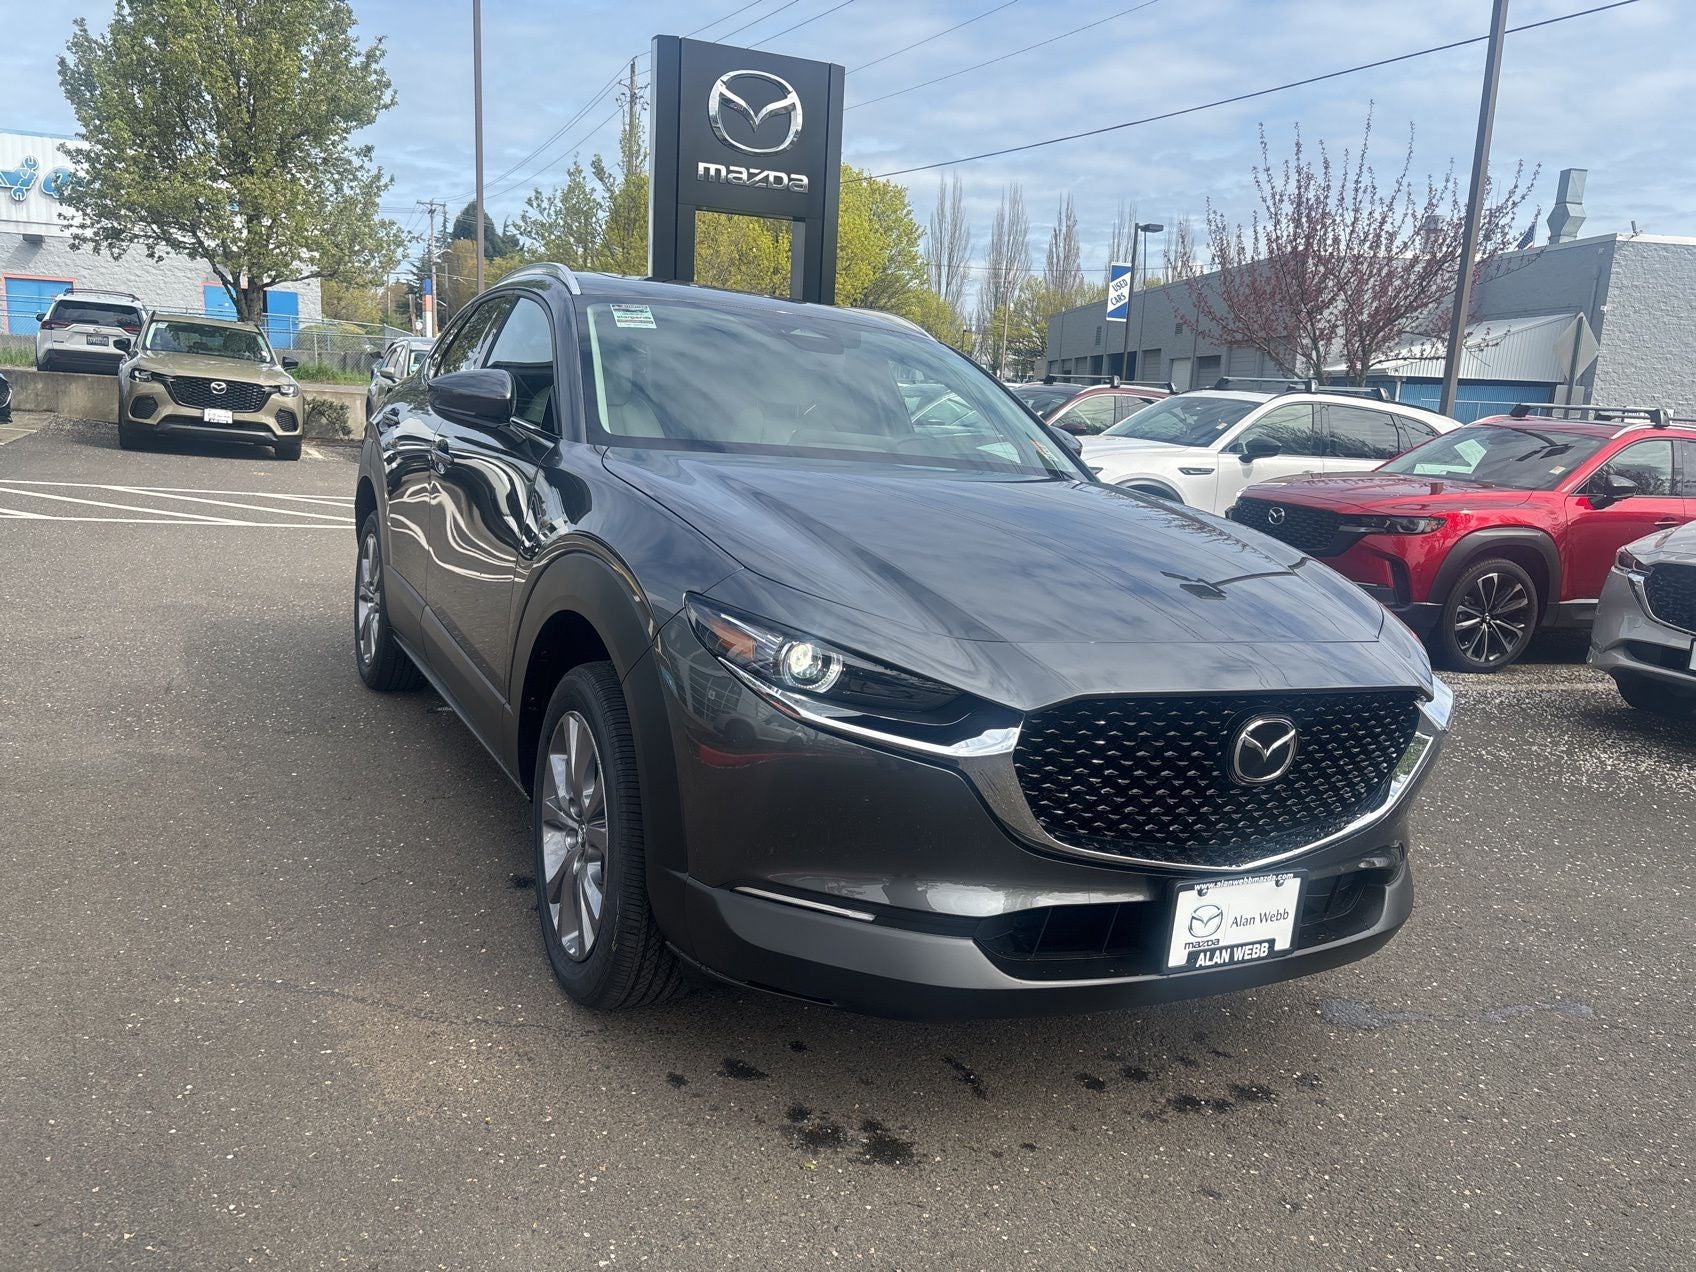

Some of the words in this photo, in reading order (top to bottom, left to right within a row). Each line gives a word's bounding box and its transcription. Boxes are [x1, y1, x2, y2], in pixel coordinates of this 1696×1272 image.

[697, 161, 809, 193] mazda
[1111, 279, 1128, 292] USED
[1110, 292, 1126, 305] CARS
[1230, 915, 1256, 928] Alan
[1259, 909, 1289, 924] Webb
[1184, 938, 1220, 950] mazda
[1196, 949, 1231, 968] ALAN
[1233, 942, 1269, 961] WEBB
